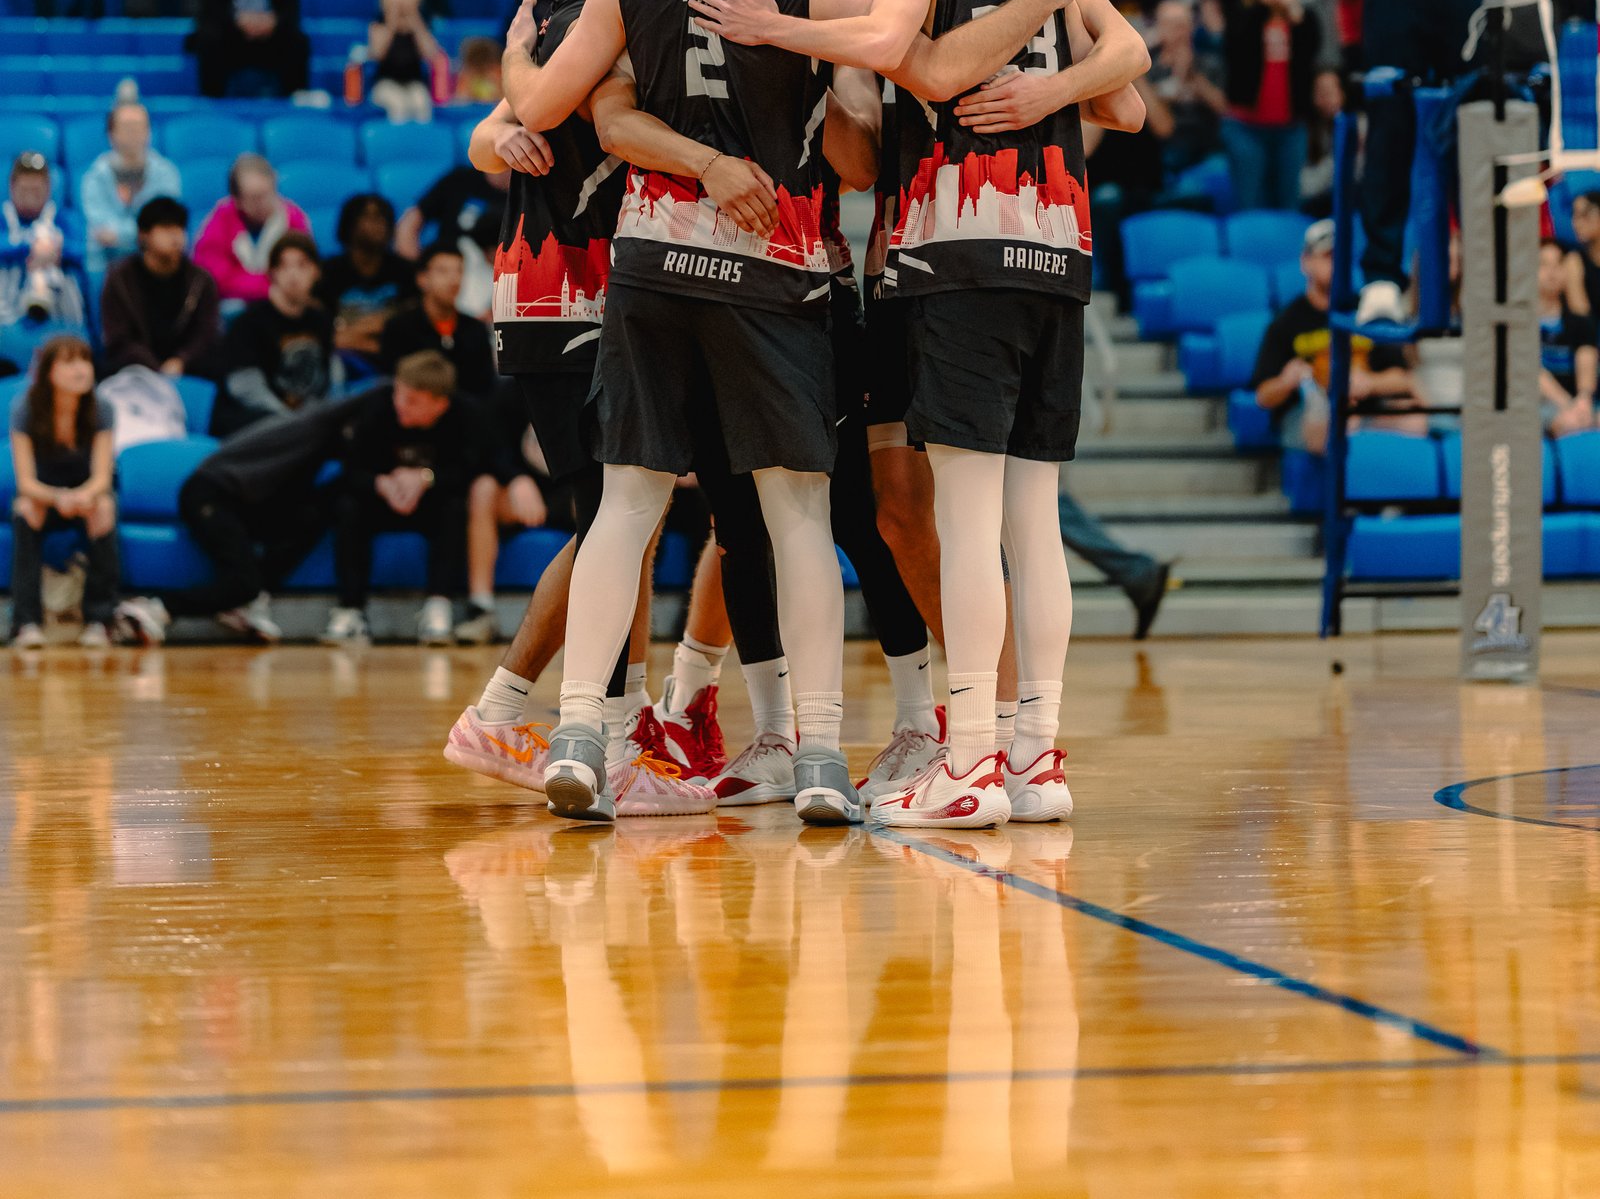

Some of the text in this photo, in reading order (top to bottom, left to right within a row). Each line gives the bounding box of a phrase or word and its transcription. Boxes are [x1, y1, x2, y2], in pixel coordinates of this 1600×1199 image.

[685, 16, 730, 99] 2
[663, 250, 744, 283] RAIDERS
[1003, 246, 1068, 276] RAIDERS
